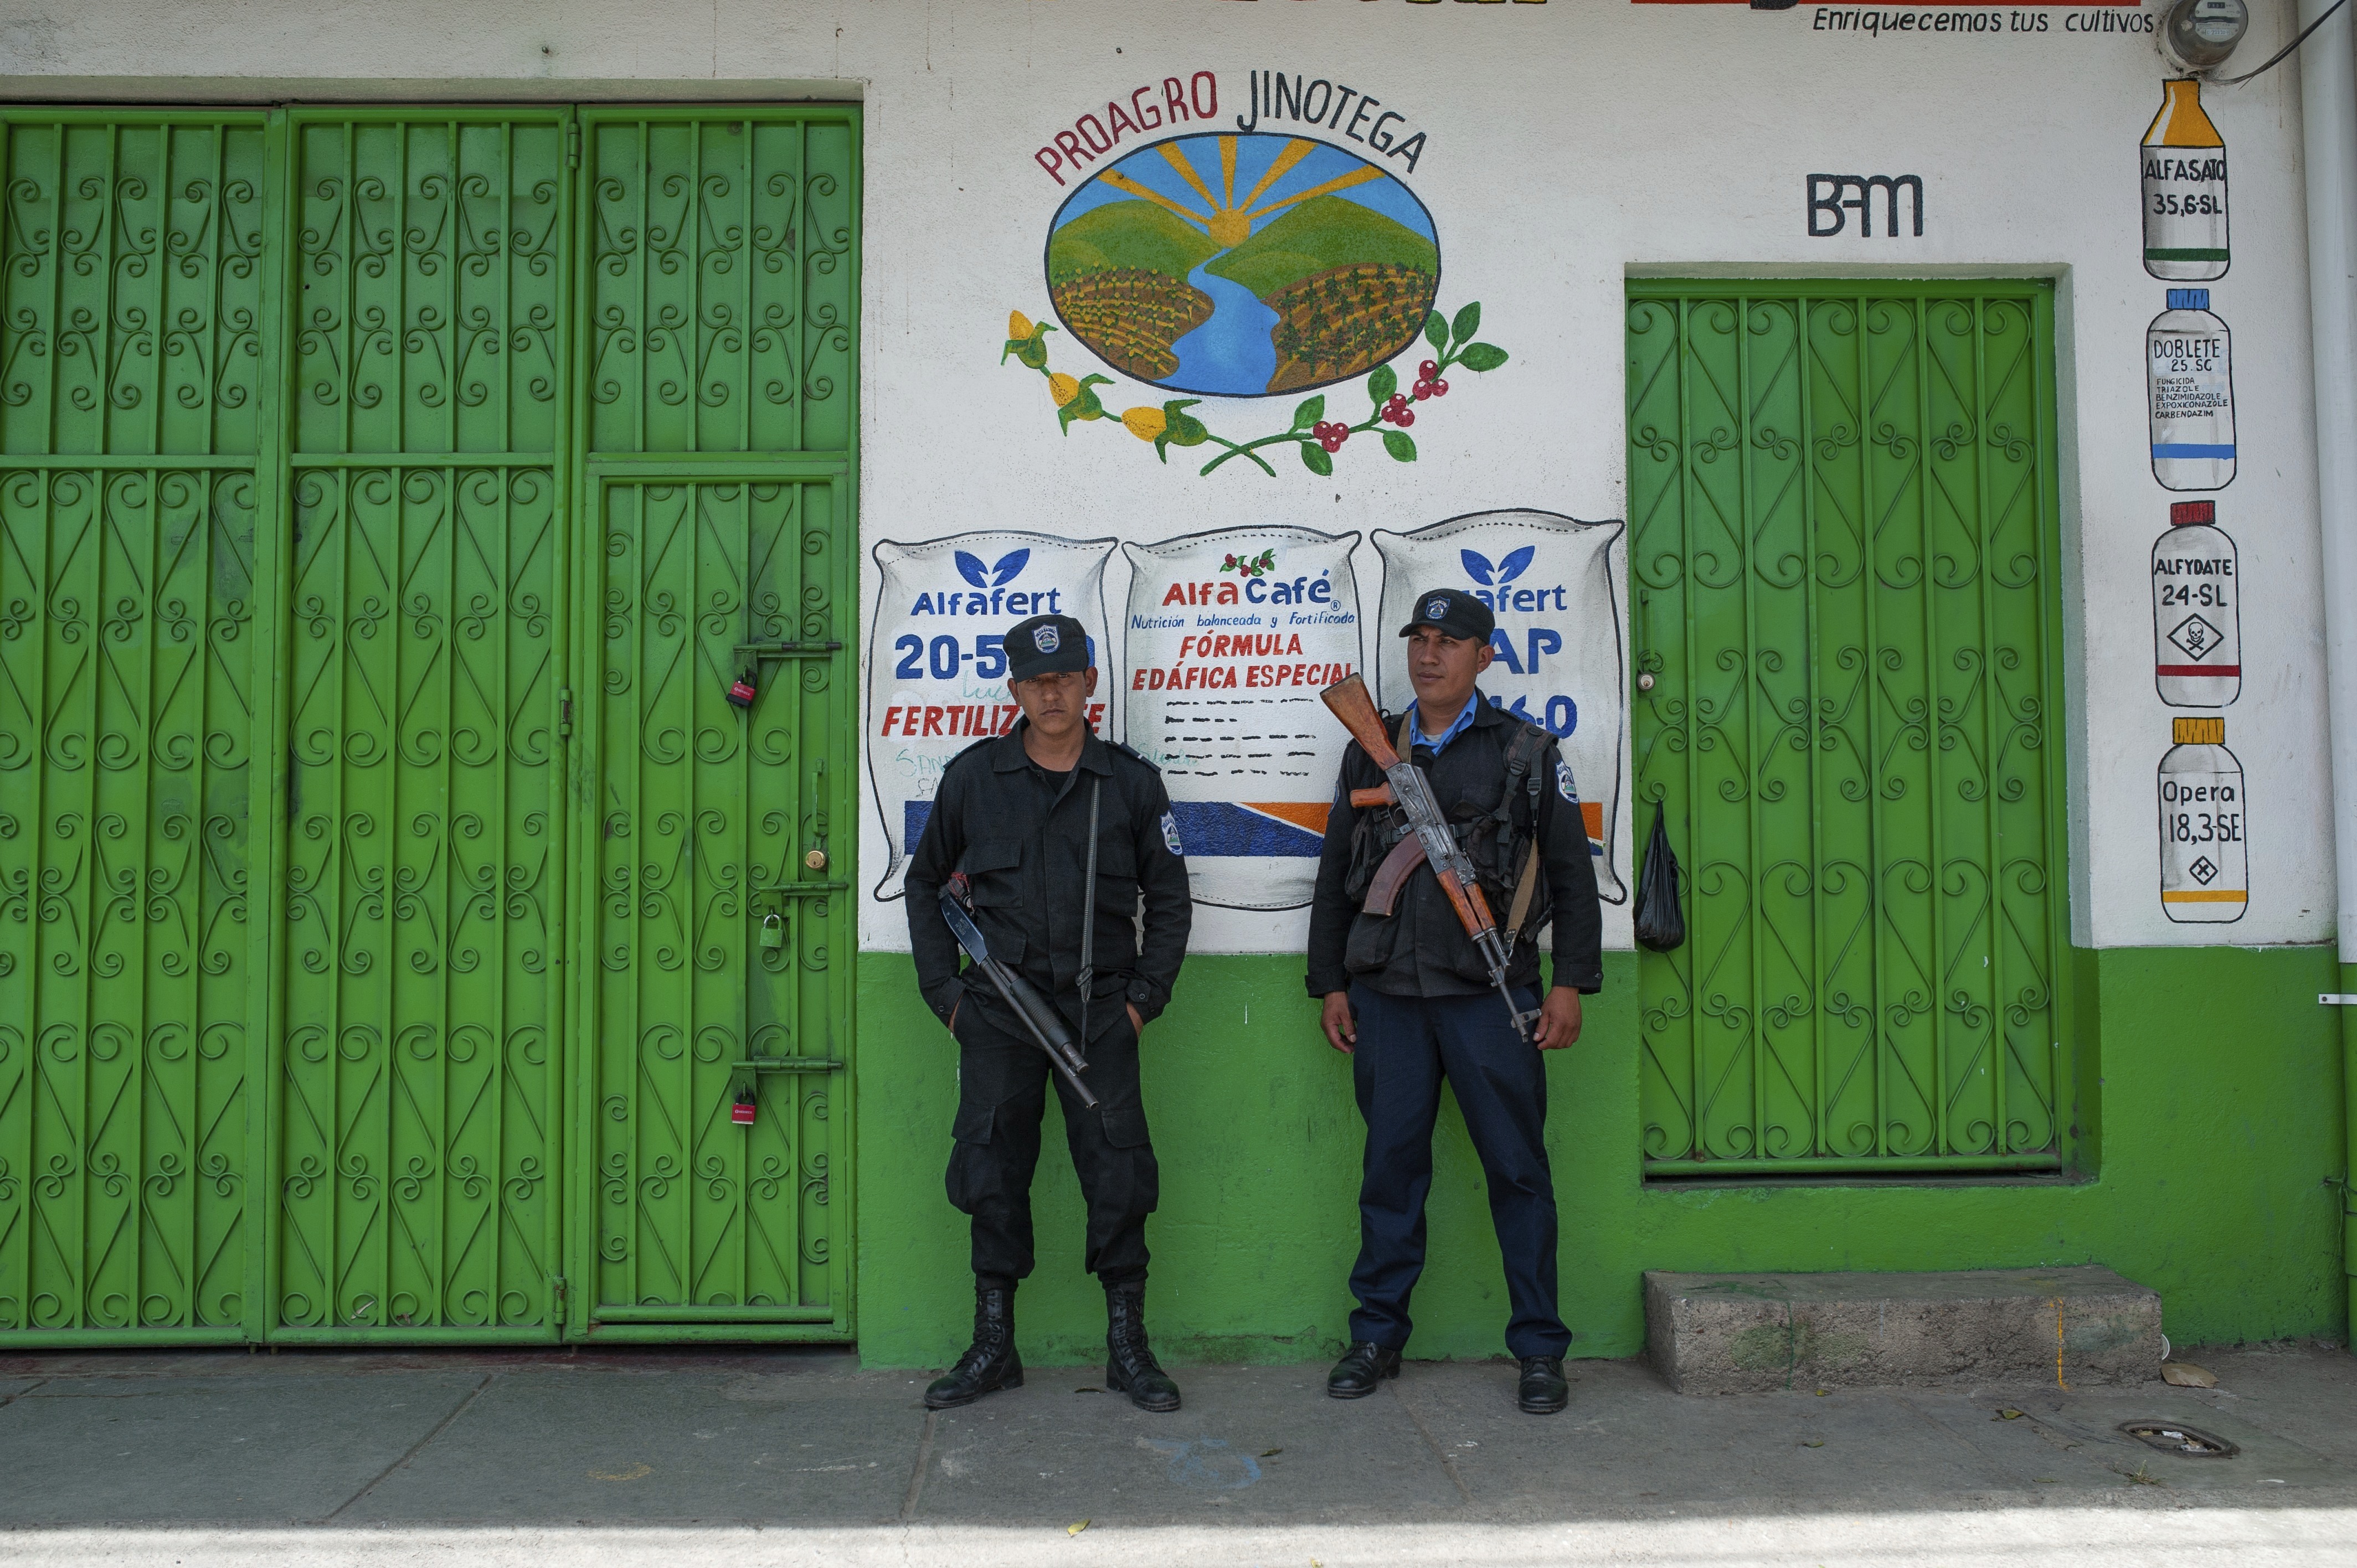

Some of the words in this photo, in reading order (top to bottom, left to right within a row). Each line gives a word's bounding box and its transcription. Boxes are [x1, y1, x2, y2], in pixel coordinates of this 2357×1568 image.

[1813, 8, 2001, 37] Enriquecemos
[2011, 10, 2048, 33] tus
[2065, 9, 2154, 33] cultivos
[1034, 70, 1218, 186] PROAGRO
[1237, 70, 1427, 173] JINOTEGA
[2144, 158, 2226, 182] ALFASATO
[2154, 339, 2221, 358] DOBLETE
[2156, 393, 2221, 401] BENZIMIDAZOLE
[2156, 399, 2228, 410] EXPOXICONAZOLE
[2155, 410, 2214, 419] CARBENDAZIM
[2154, 559, 2232, 576] ALFYDATE
[910, 587, 1062, 616] Alfafert
[2162, 583, 2227, 607] 24-SL
[1131, 614, 1185, 629] Nutrición
[1197, 613, 1261, 627] balanceada
[1270, 617, 1278, 628] y
[1179, 629, 1303, 658] FÓRMULA
[1131, 661, 1238, 691] EDÁFICA
[2163, 781, 2235, 806] Opera
